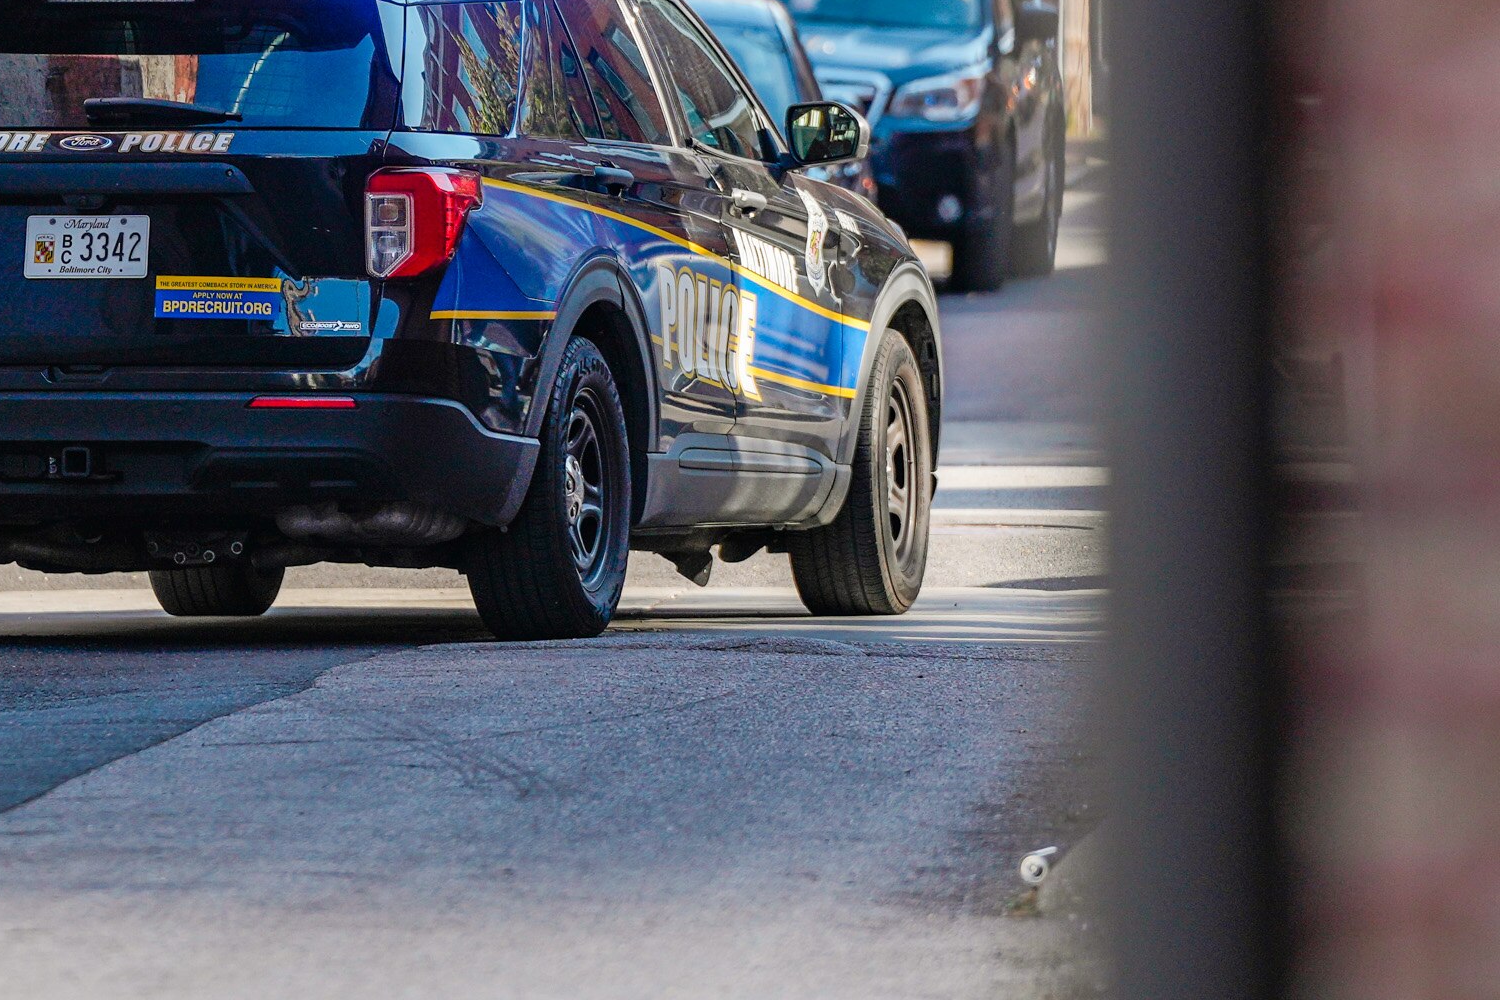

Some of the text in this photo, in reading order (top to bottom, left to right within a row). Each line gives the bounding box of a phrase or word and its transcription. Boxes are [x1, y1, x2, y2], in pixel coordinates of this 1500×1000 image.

[71, 136, 100, 147] Ford
[118, 133, 235, 153] POLICE
[64, 219, 111, 232] Maryland
[80, 232, 142, 262] 3342
[59, 266, 113, 275] Baltimore City
[216, 292, 232, 300] NOW
[163, 300, 273, 316] BPDRECRUIT.ORG
[657, 262, 763, 402] POLICE
